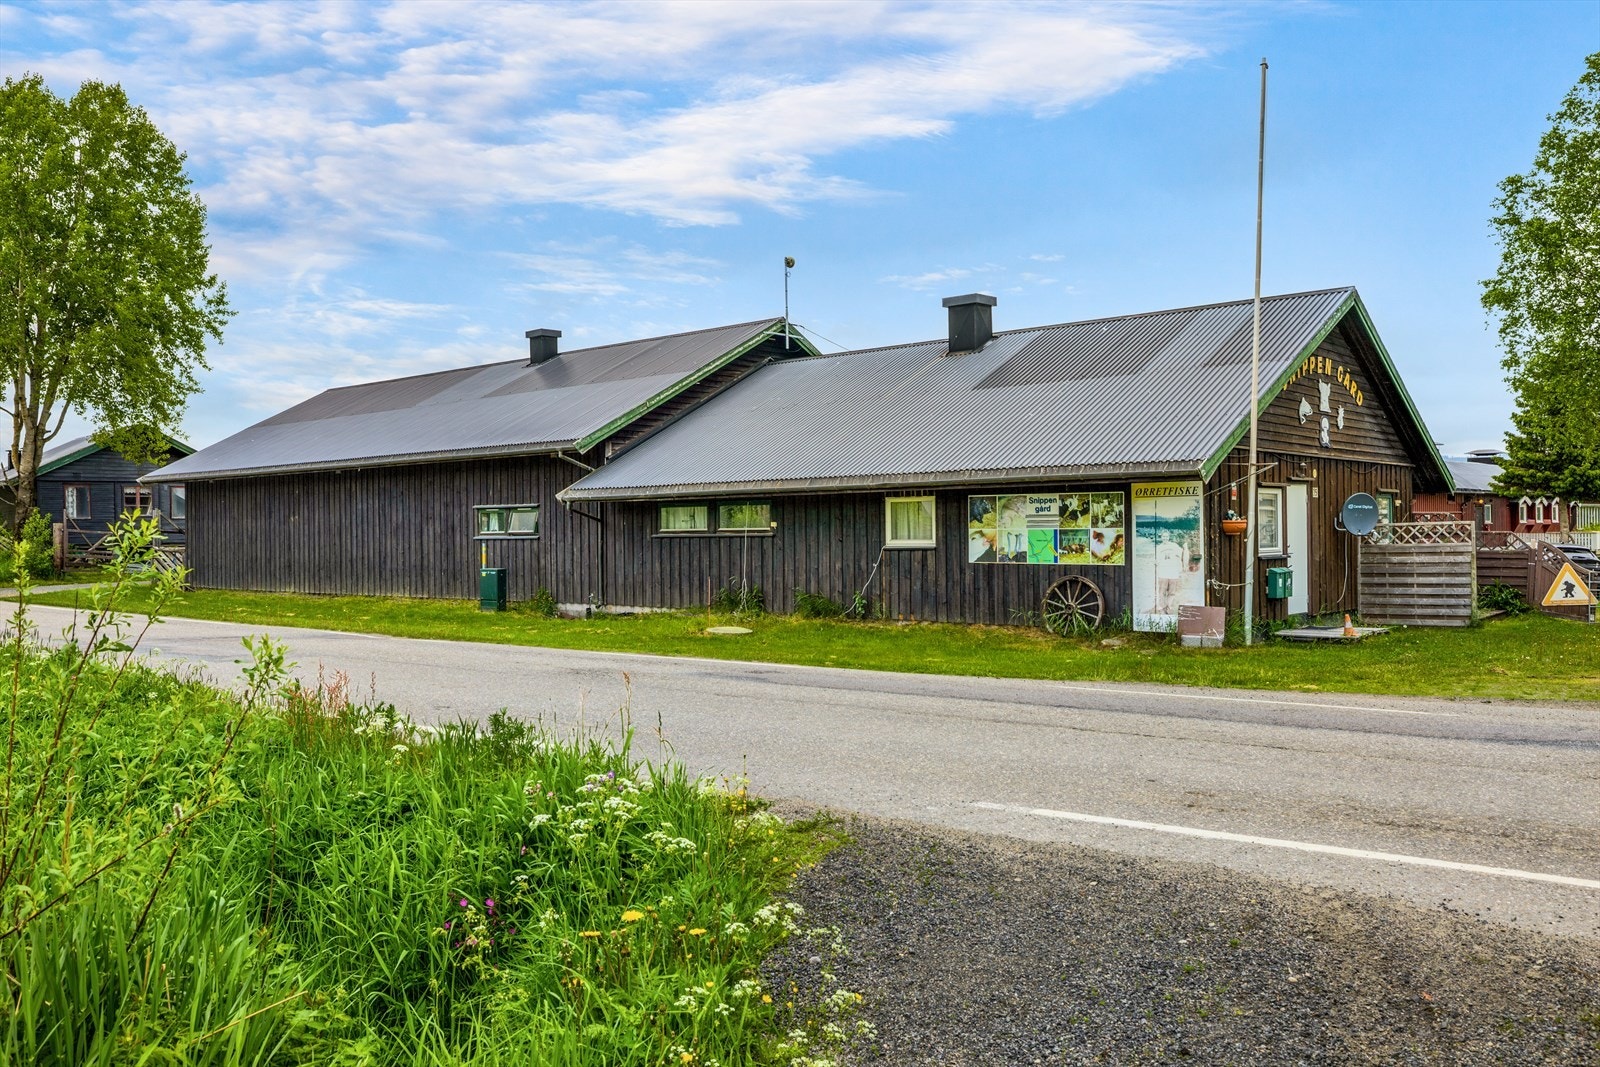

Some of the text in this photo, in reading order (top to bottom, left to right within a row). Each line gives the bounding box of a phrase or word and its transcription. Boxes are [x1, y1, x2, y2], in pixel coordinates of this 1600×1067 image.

[1135, 486, 1199, 496] ØRRETFISKE
[1028, 496, 1057, 505] Snippen
[1035, 505, 1051, 513] gård
